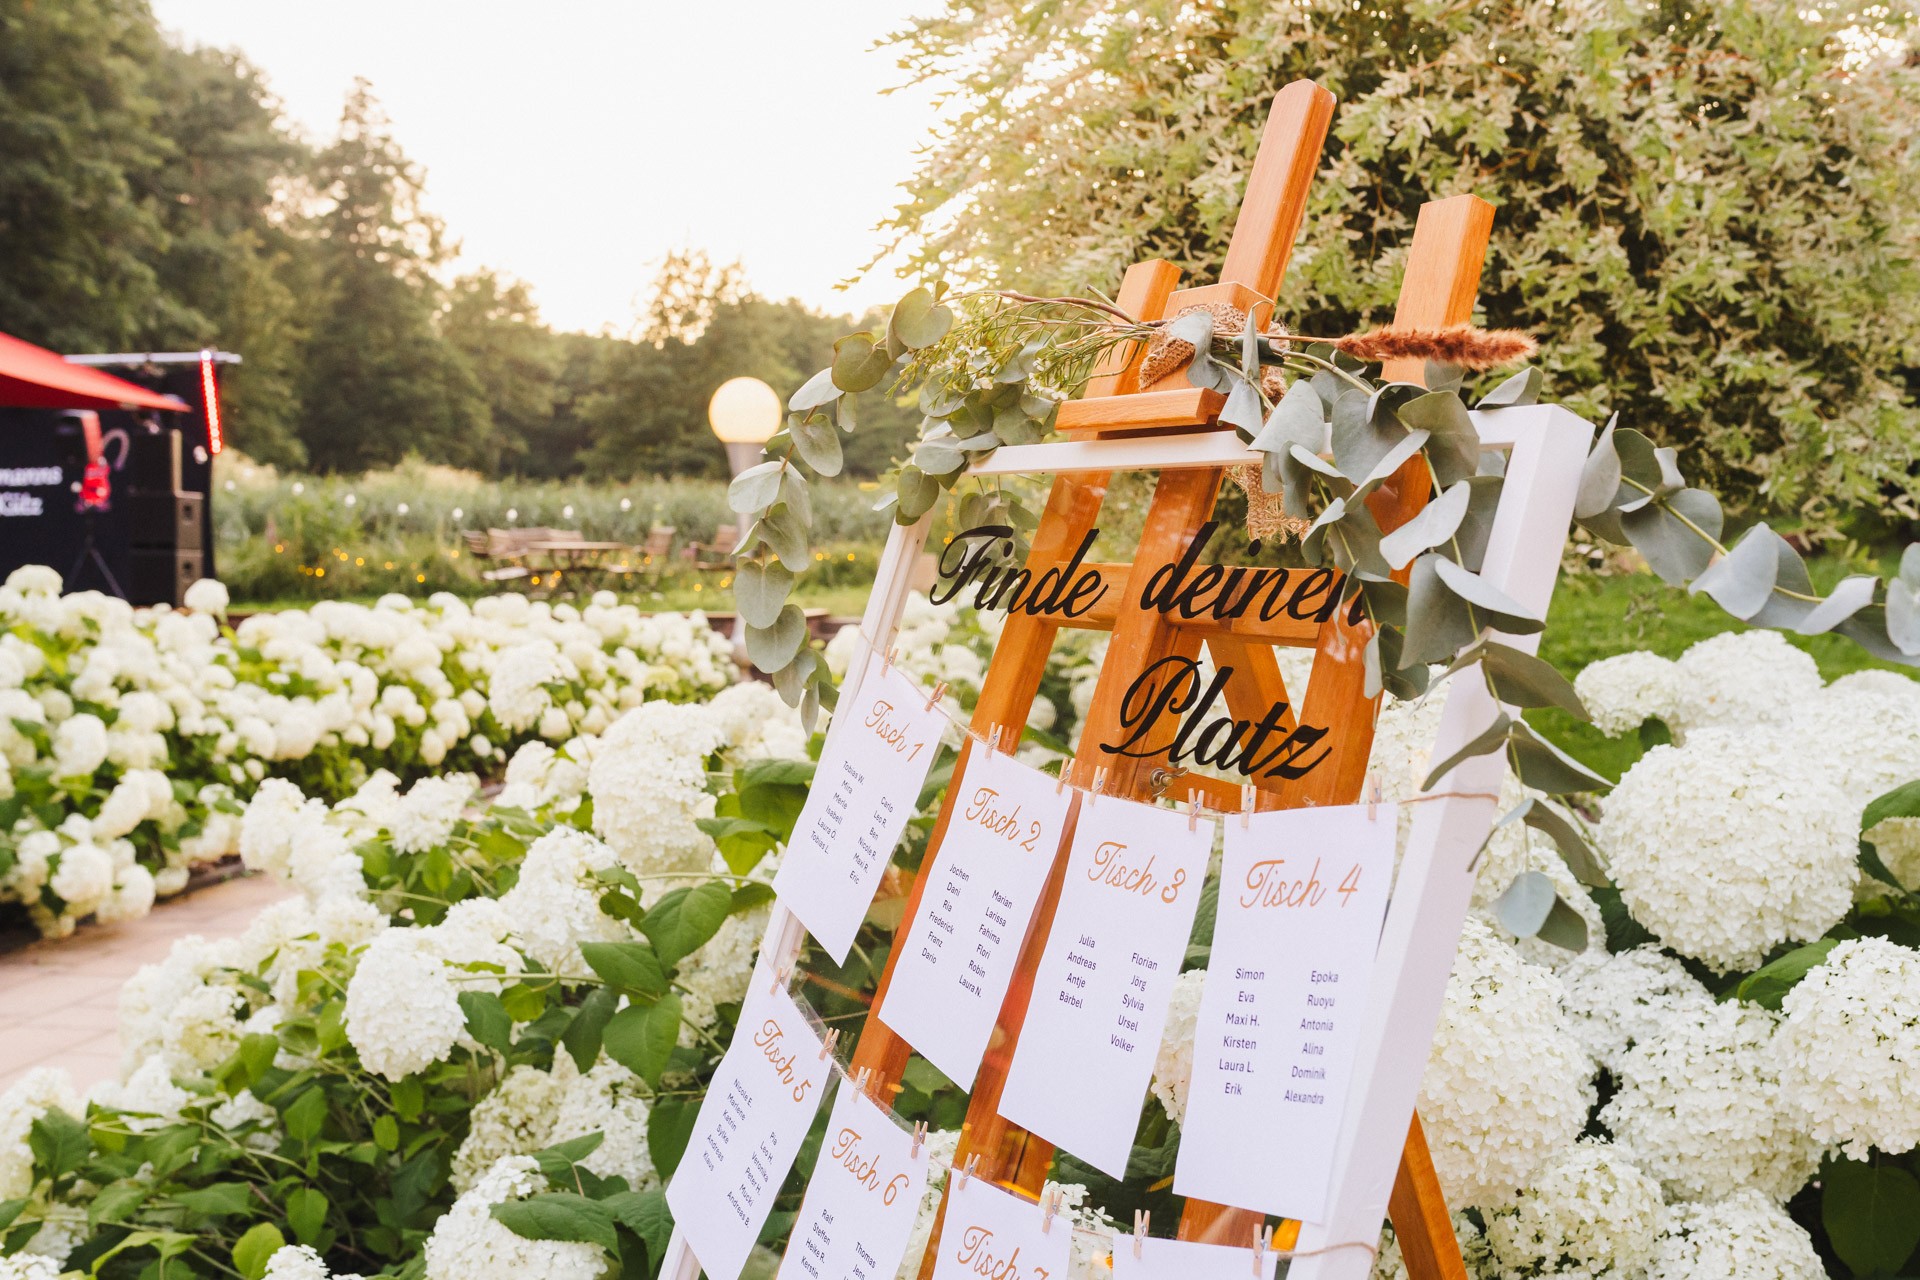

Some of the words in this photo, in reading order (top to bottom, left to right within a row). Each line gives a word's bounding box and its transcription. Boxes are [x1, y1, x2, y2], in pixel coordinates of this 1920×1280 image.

[929, 525, 1109, 618] Finde
[1099, 655, 1333, 780] Platz
[865, 700, 910, 752] Tisch
[907, 743, 924, 762] 1
[843, 760, 858, 779] Tobias
[841, 779, 853, 794] Mira
[833, 792, 847, 809] Merle
[881, 796, 893, 813] Carlo
[825, 805, 843, 825] Isabell
[966, 787, 1021, 840] Tisch
[1019, 820, 1041, 852] 2
[817, 817, 831, 835] Laura
[811, 830, 825, 850] Tobias
[858, 836, 872, 855] Nicole
[853, 852, 865, 868] Maxi
[949, 863, 969, 881] Jochen
[1088, 841, 1157, 895] Tisch
[1161, 868, 1186, 903] 3
[946, 881, 961, 896] Dani
[1240, 857, 1326, 908] Tisch
[1337, 863, 1362, 907] 4
[992, 889, 1012, 909] Marian
[929, 911, 954, 934] Frederick
[985, 906, 1006, 927] Larissa
[928, 931, 943, 948] Franz
[978, 923, 1000, 944] Fahima
[1078, 934, 1095, 948] Julia
[921, 947, 936, 964] Dario
[976, 943, 991, 959] Flori
[1066, 951, 1096, 970] Andreas
[968, 959, 985, 978] Robin
[1131, 952, 1158, 970] Florian
[959, 974, 975, 993] Laura
[1066, 972, 1086, 988] Antje
[1130, 975, 1147, 992] Jörg
[1235, 968, 1264, 980] Simon
[1310, 970, 1338, 985] Epoka
[1059, 990, 1083, 1009] Bärbel
[1122, 993, 1144, 1011] Sylvia
[1238, 990, 1254, 1003] Eva
[1307, 994, 1335, 1009] Ruoyu
[1118, 1014, 1138, 1032] Ursel
[1225, 1013, 1248, 1025] Maxi
[1299, 1018, 1333, 1031] Antonia
[1111, 1034, 1134, 1052] Volker
[1223, 1036, 1256, 1049] Kirsten
[1301, 1042, 1324, 1055] Alina
[754, 1019, 796, 1085] Tisch
[793, 1079, 811, 1102] 5
[1219, 1058, 1244, 1072] Laura
[1291, 1065, 1326, 1079] Dominik
[733, 1078, 748, 1101] Nicole
[1224, 1082, 1242, 1095] Erik
[1283, 1089, 1324, 1104] Alexandra
[727, 1093, 745, 1122] Marlene
[722, 1109, 736, 1131] Katrin
[716, 1124, 729, 1144] Sylke
[707, 1134, 724, 1162] Andreas
[703, 1150, 714, 1171] Klaus
[751, 1151, 768, 1182] Veronika
[832, 1128, 880, 1191] Tisch
[883, 1173, 909, 1206] 6
[745, 1166, 757, 1187] Peter
[739, 1184, 754, 1207] Mucki
[727, 1191, 745, 1220] Andreas
[821, 1209, 834, 1224] Ralf
[812, 1222, 830, 1245] Steffen
[805, 1237, 820, 1257] Heike
[855, 1241, 876, 1268] Thomas
[801, 1256, 818, 1279] Kerstin
[852, 1264, 865, 1280] Jens
